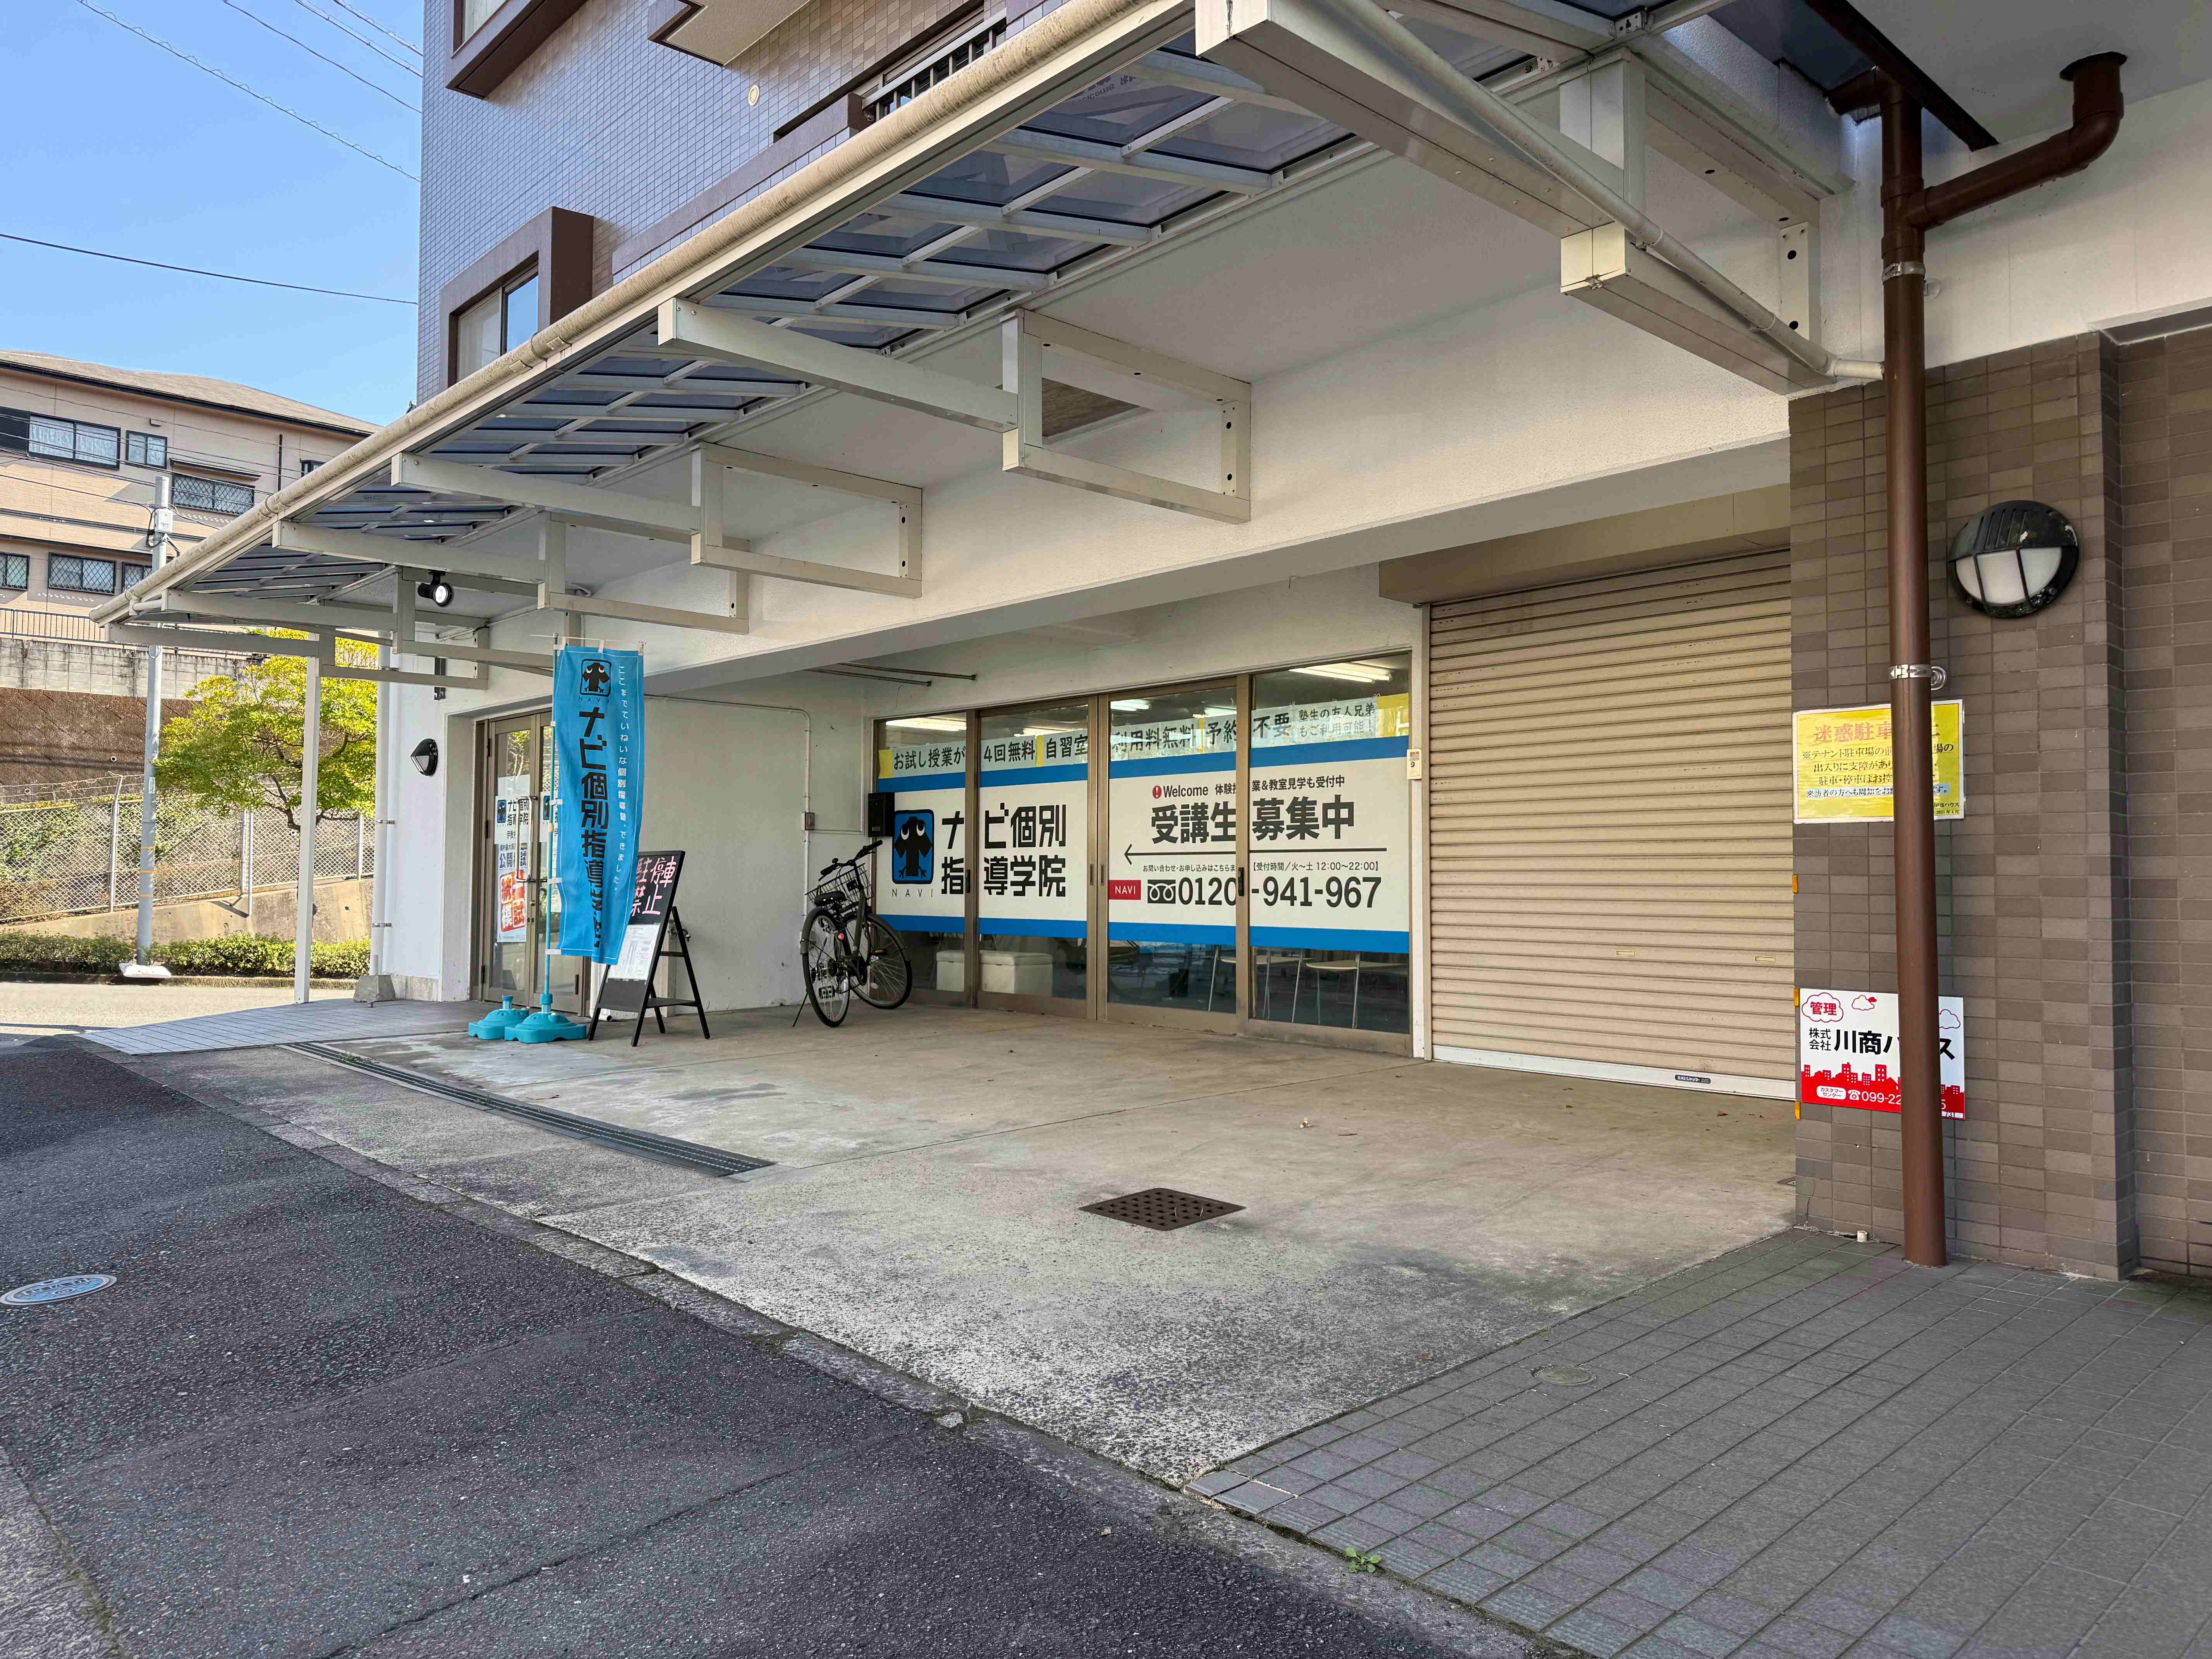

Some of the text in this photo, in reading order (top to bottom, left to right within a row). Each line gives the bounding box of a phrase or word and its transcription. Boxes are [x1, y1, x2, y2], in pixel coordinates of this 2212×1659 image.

[1298, 702, 1376, 721] 塾生の友人兄弟
[1163, 775, 1345, 798] Welcome 体験業&教室見学も受付中
[891, 888, 933, 898] NAVI
[1115, 885, 1136, 895] NAVI
[1810, 1001, 1837, 1016] 管理
